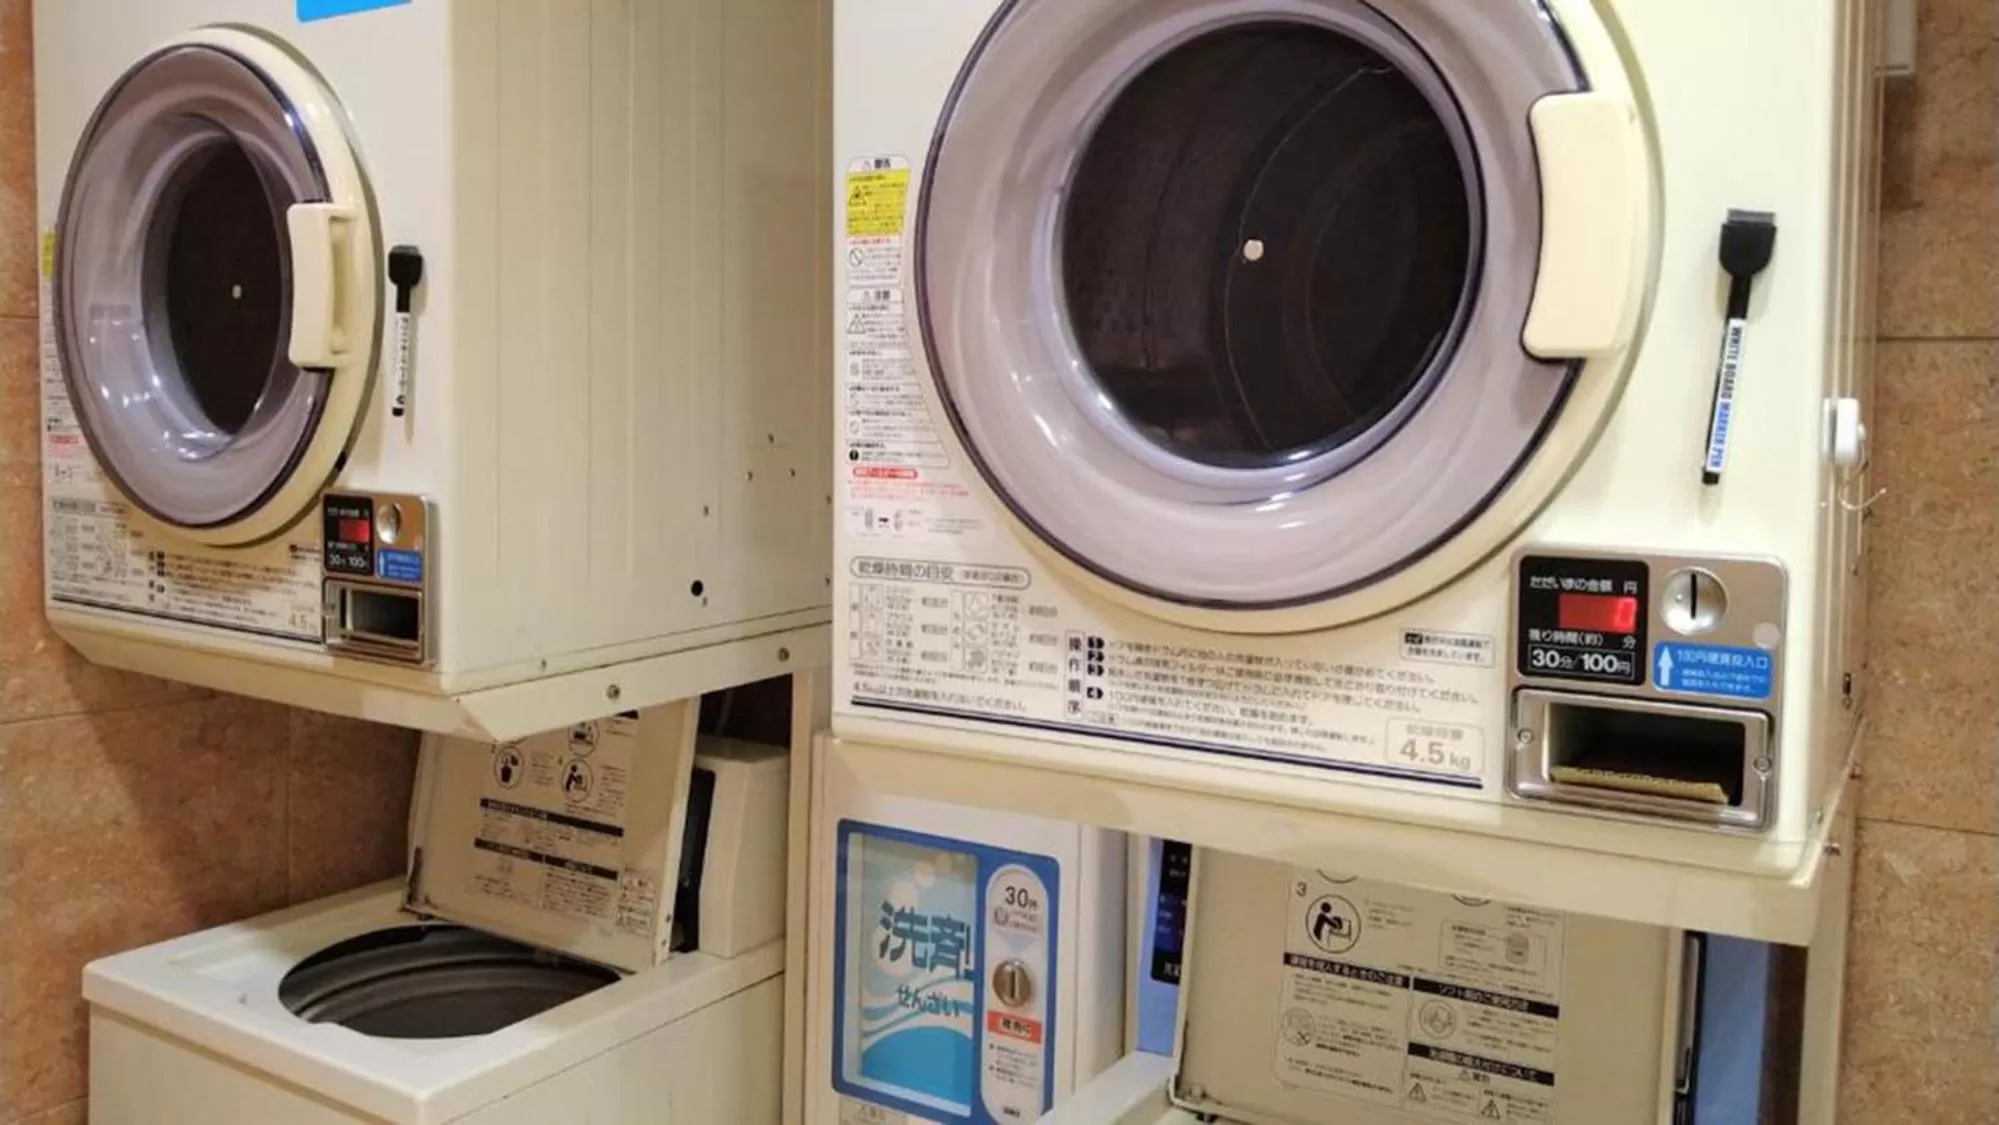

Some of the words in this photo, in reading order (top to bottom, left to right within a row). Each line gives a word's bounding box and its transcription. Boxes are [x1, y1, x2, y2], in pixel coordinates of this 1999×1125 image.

[1297, 882, 1307, 897] 3
[880, 901, 976, 982] 洗剤
[897, 984, 961, 1017] せんざい
